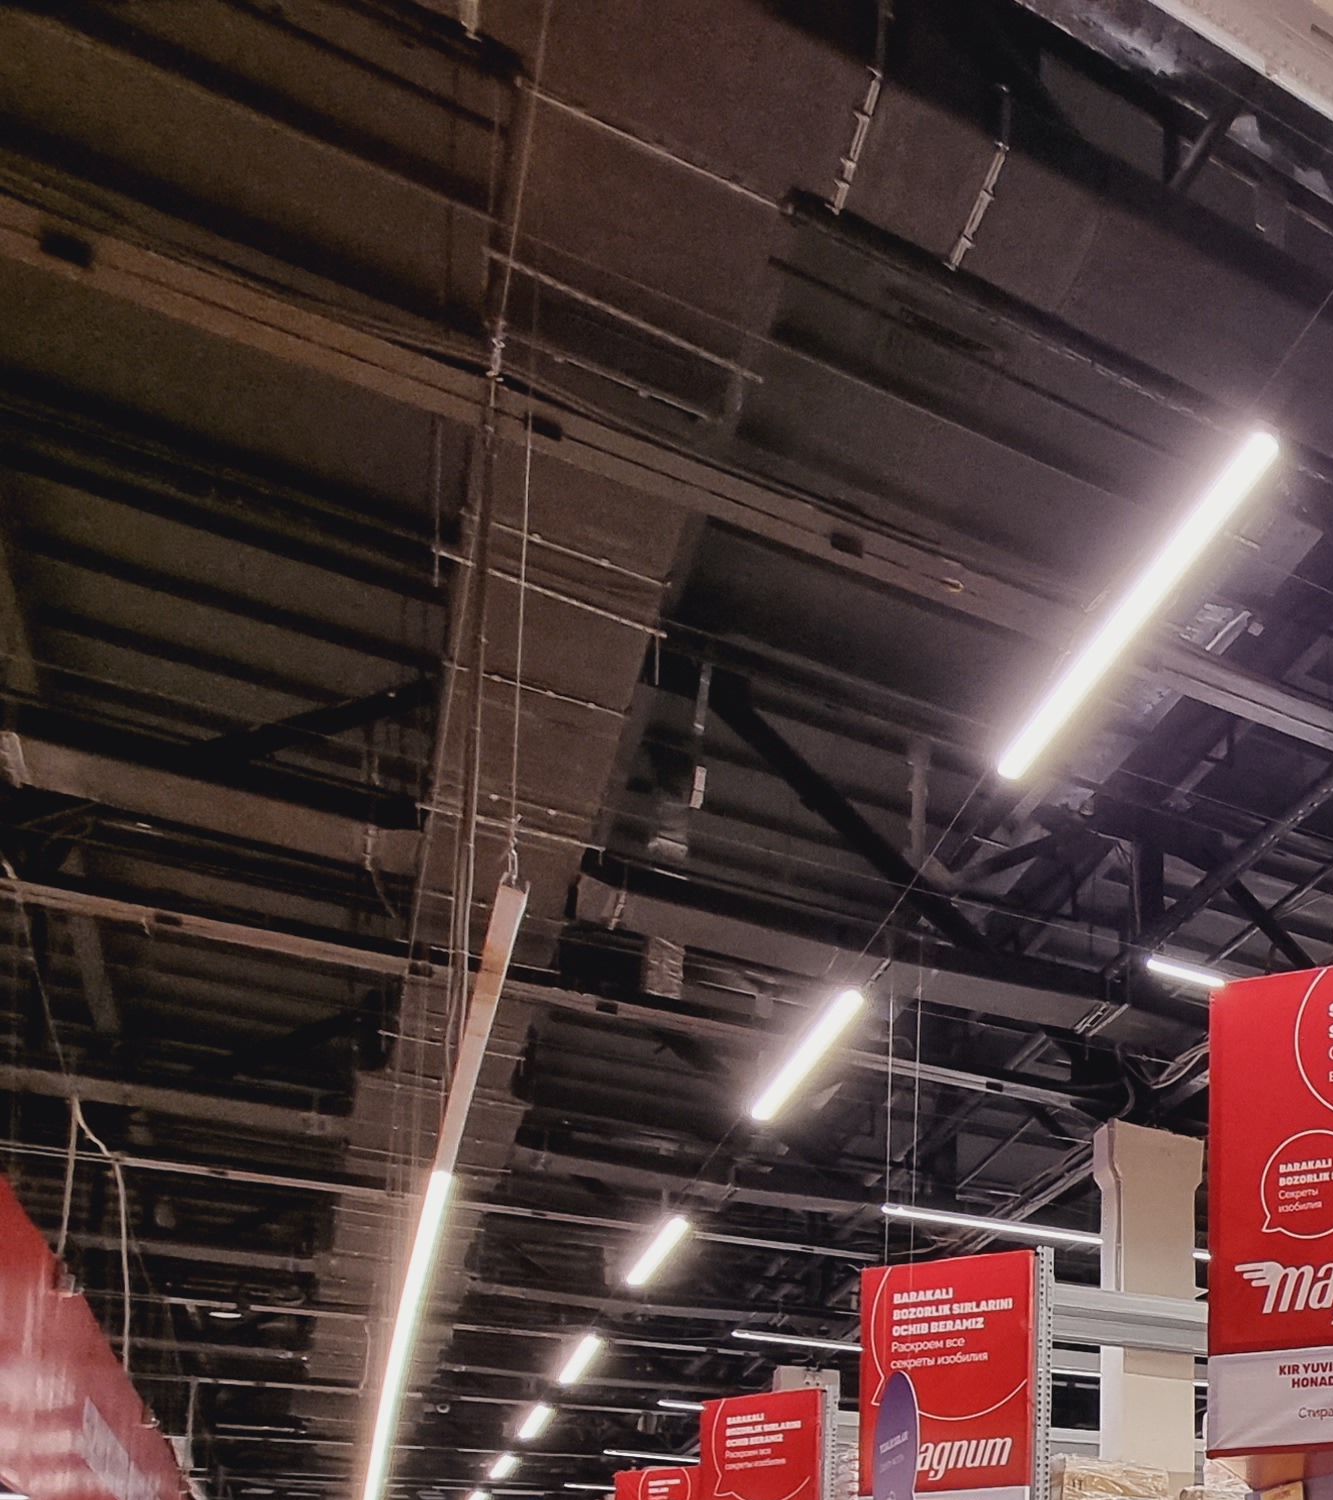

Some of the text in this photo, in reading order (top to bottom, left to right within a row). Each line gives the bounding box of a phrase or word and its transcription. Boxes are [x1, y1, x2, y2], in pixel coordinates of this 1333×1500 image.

[893, 1287, 954, 1304] BARAKALI
[892, 1297, 1014, 1320] BOZORLIK SIRLARINI
[892, 1317, 985, 1337] OCHIB BERAMIZ
[1279, 1364, 1300, 1376] KIR
[916, 1437, 1013, 1481] agnum
